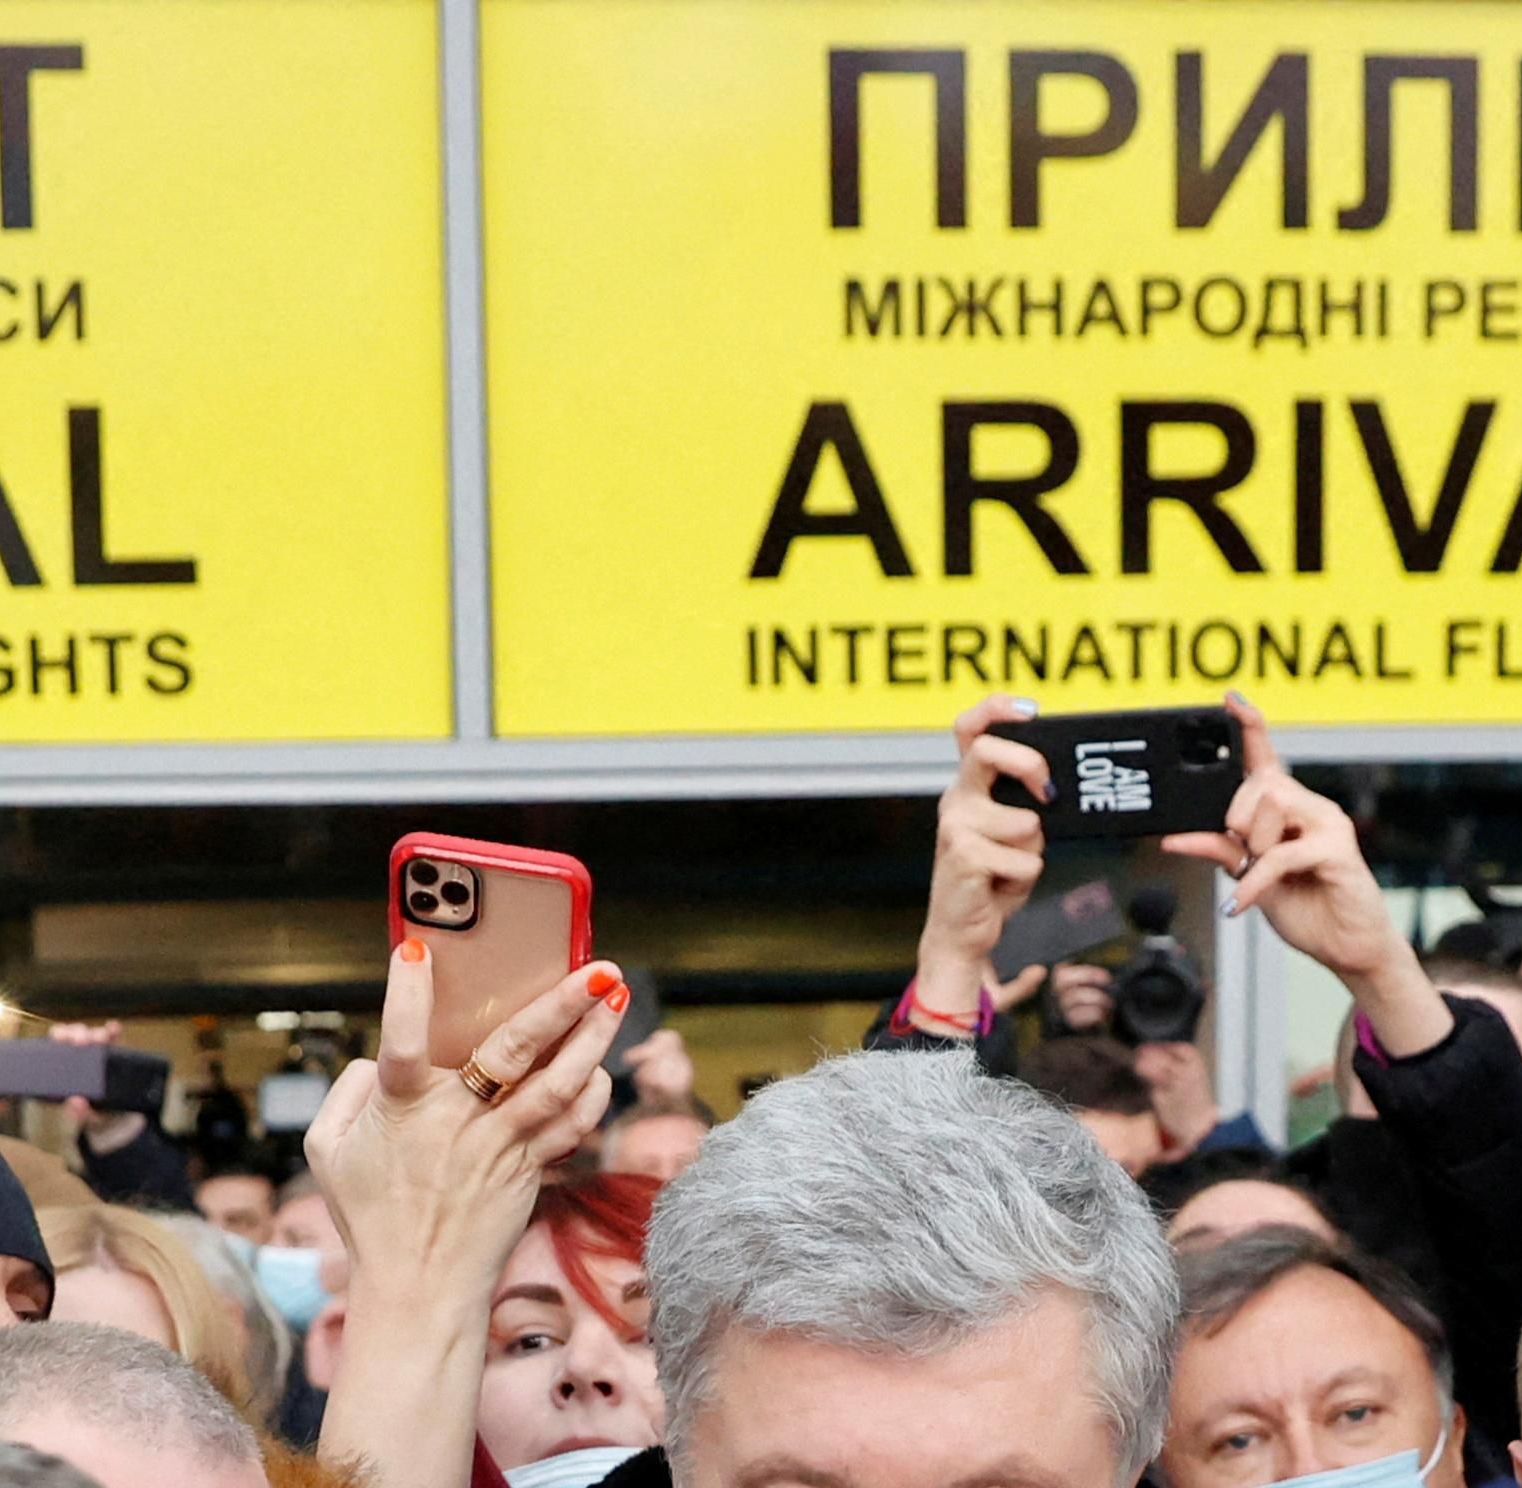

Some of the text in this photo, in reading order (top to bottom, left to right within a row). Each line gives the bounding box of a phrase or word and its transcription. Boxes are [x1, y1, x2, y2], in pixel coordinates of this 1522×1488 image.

[843, 277, 1386, 349] МІЖНАРОДНІ
[747, 621, 1412, 688] INTERNATIONAL
[1075, 743, 1116, 813] LOVE
[1112, 766, 1152, 812] AM
